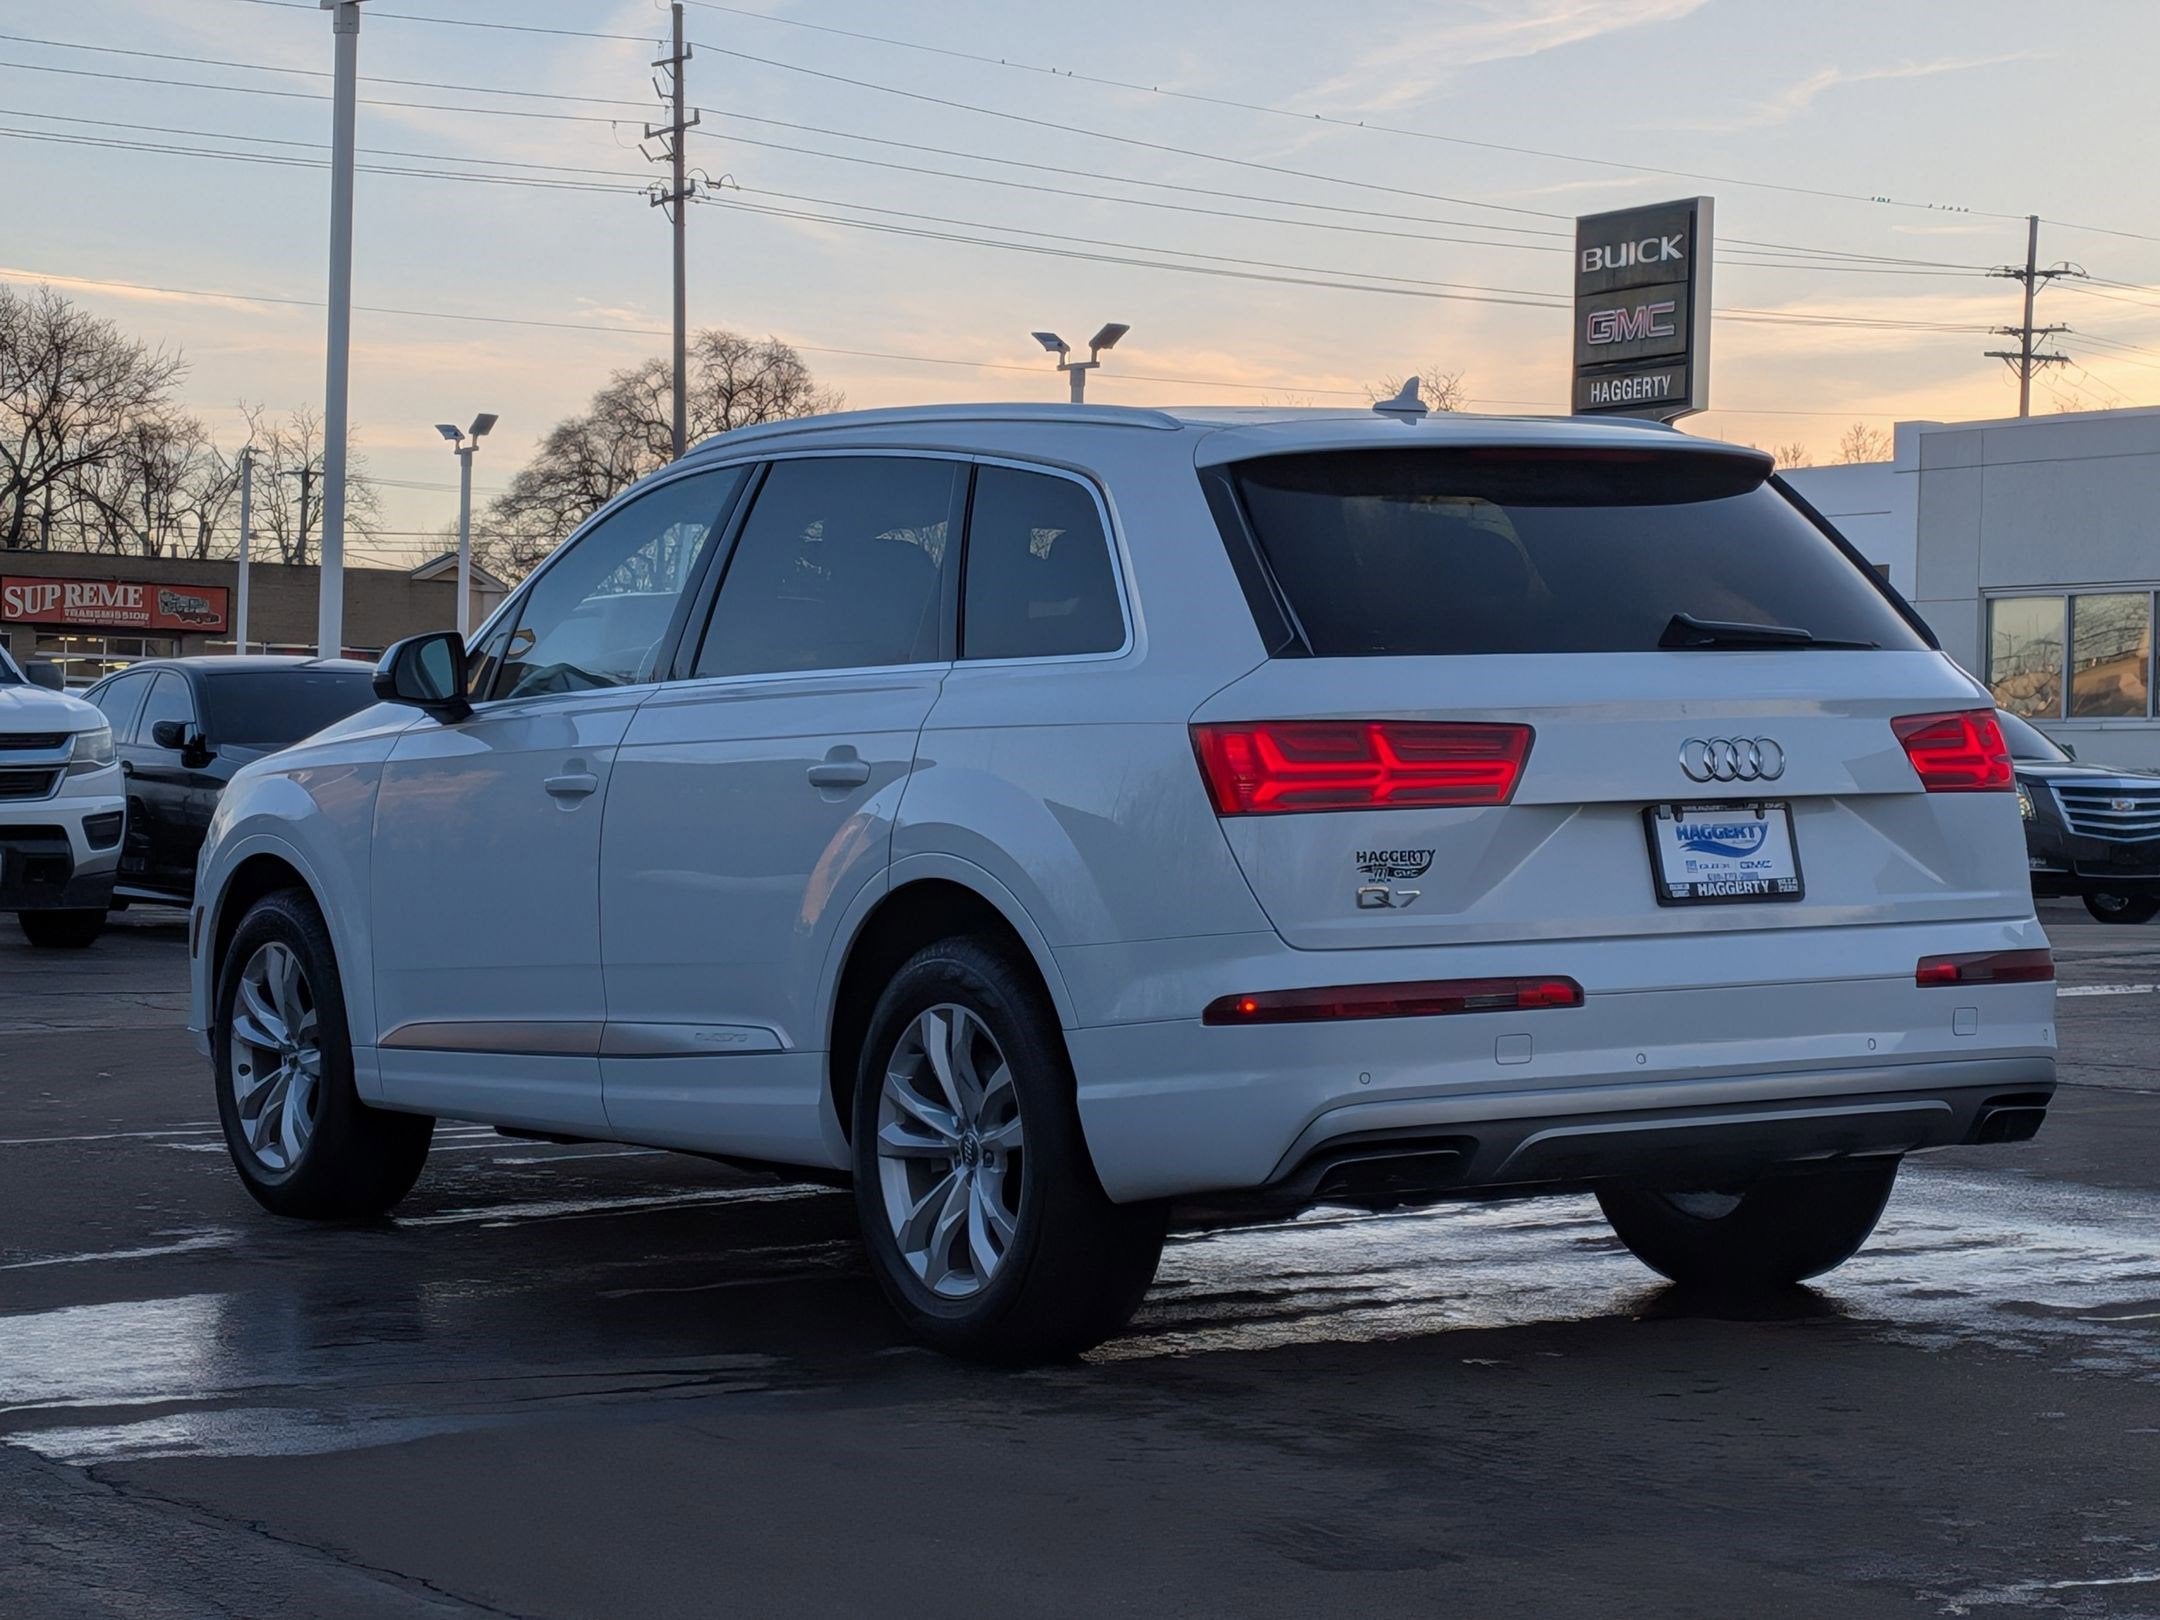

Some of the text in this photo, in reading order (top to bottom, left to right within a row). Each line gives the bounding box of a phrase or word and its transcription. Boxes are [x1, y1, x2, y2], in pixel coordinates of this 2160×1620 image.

[1582, 234, 1684, 273] BUICK
[1587, 301, 1675, 345] GMC
[1590, 375, 1672, 403] HAGGERTY
[4, 583, 143, 618] SUPREME
[1675, 821, 1769, 842] HAGGERTY
[1356, 849, 1436, 864] HAGGERTY
[1356, 886, 1421, 909] Q7
[1697, 879, 1769, 897] HAGGERTY
